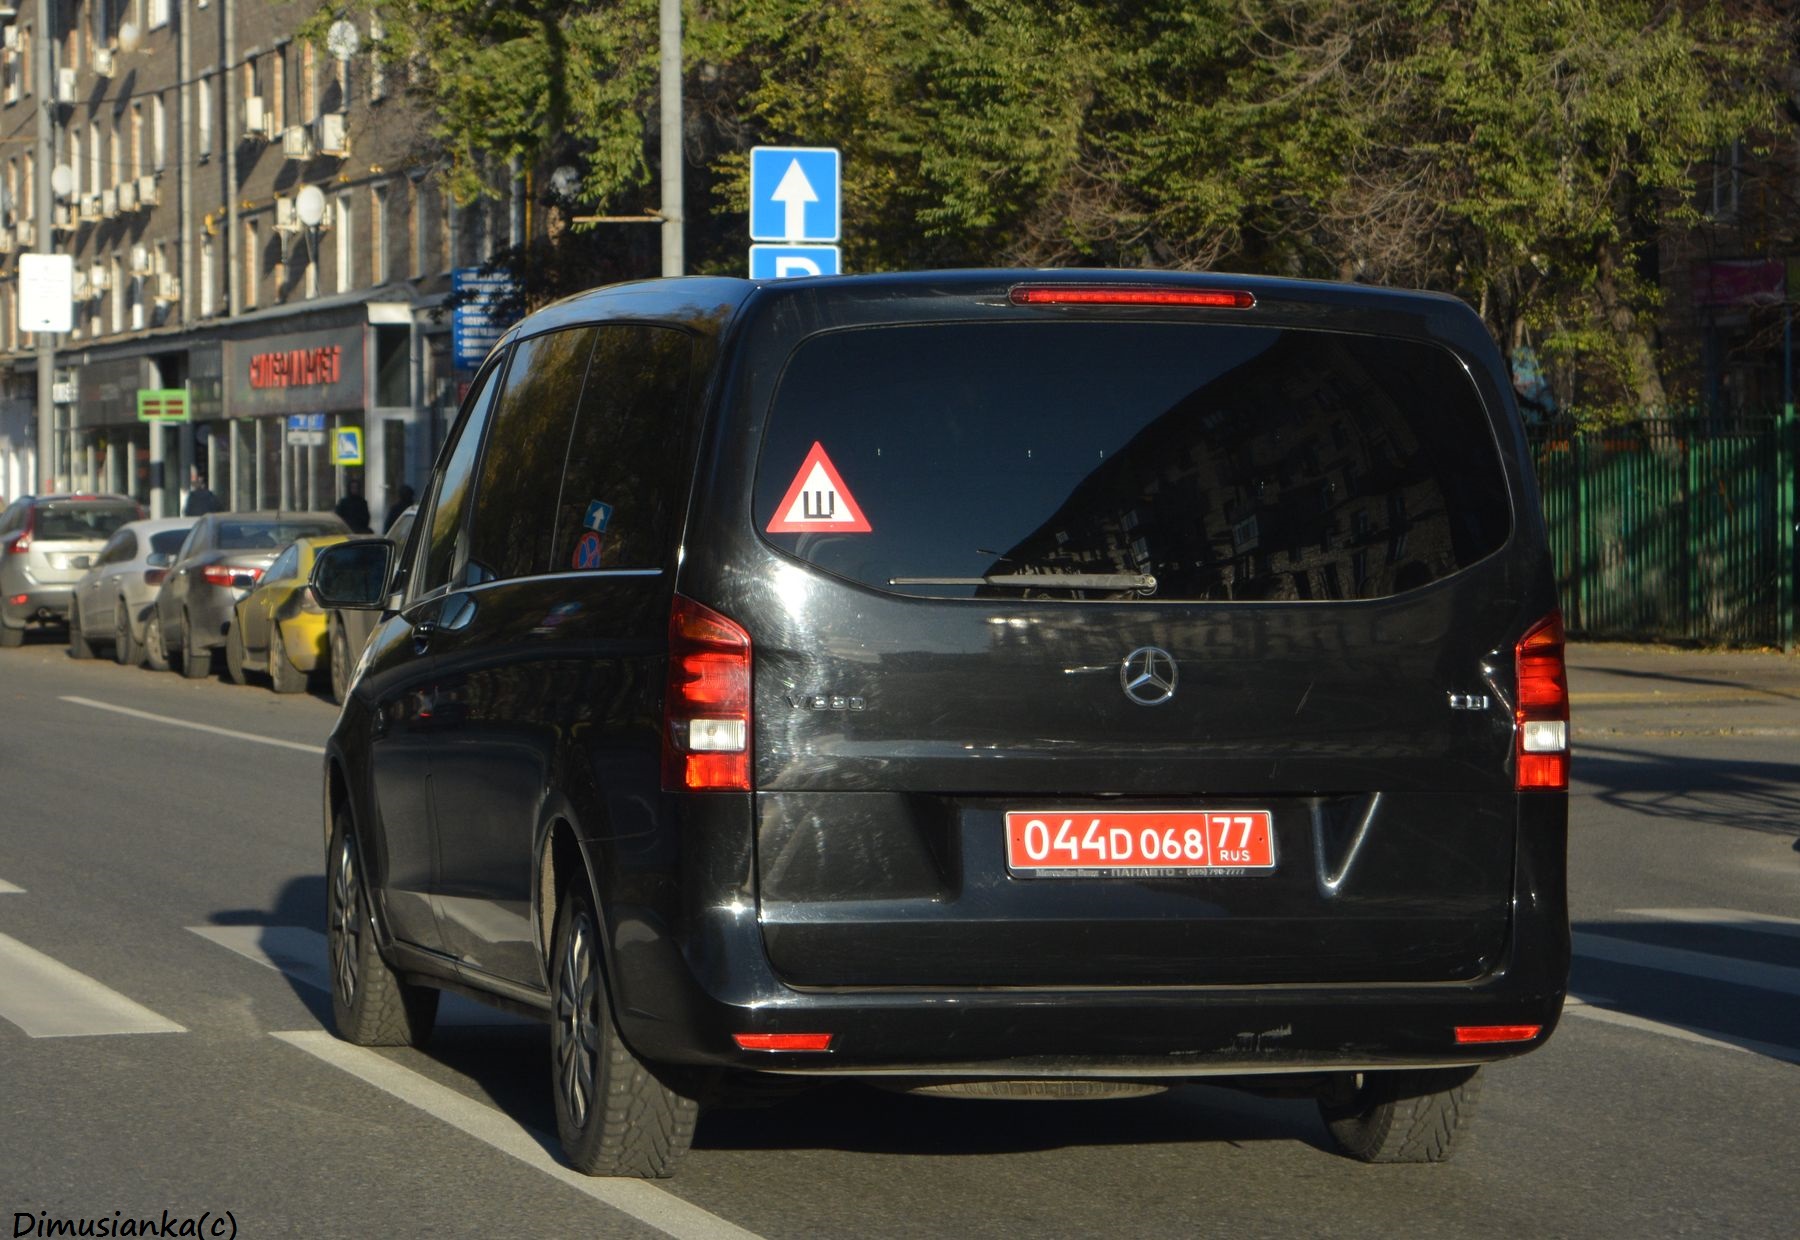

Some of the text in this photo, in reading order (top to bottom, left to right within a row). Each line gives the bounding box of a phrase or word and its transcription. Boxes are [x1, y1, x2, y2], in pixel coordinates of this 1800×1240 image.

[803, 491, 834, 519] Ш
[1212, 817, 1253, 848] 77
[1220, 850, 1250, 861] RUS
